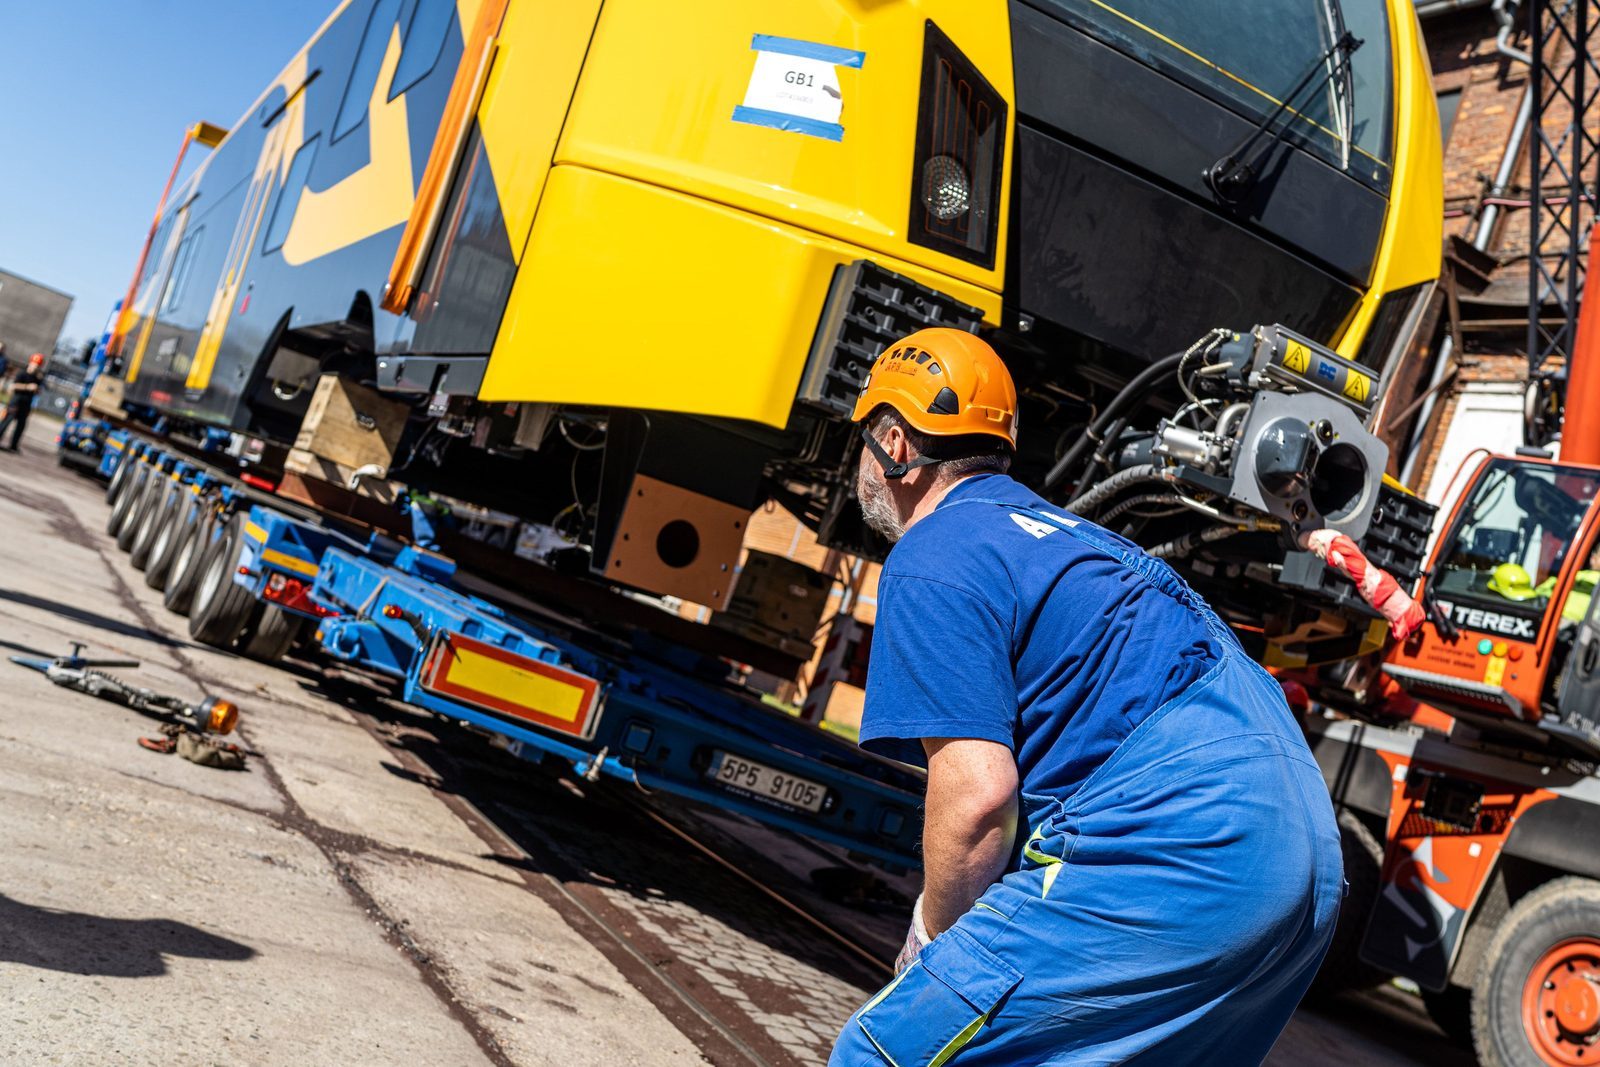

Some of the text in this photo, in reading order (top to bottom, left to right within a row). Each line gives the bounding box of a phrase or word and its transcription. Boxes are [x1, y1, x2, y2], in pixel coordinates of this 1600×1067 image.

[784, 70, 815, 88] GB1
[1455, 606, 1535, 638] TEREX
[723, 759, 761, 787] 5P5
[769, 775, 819, 806] 9105
